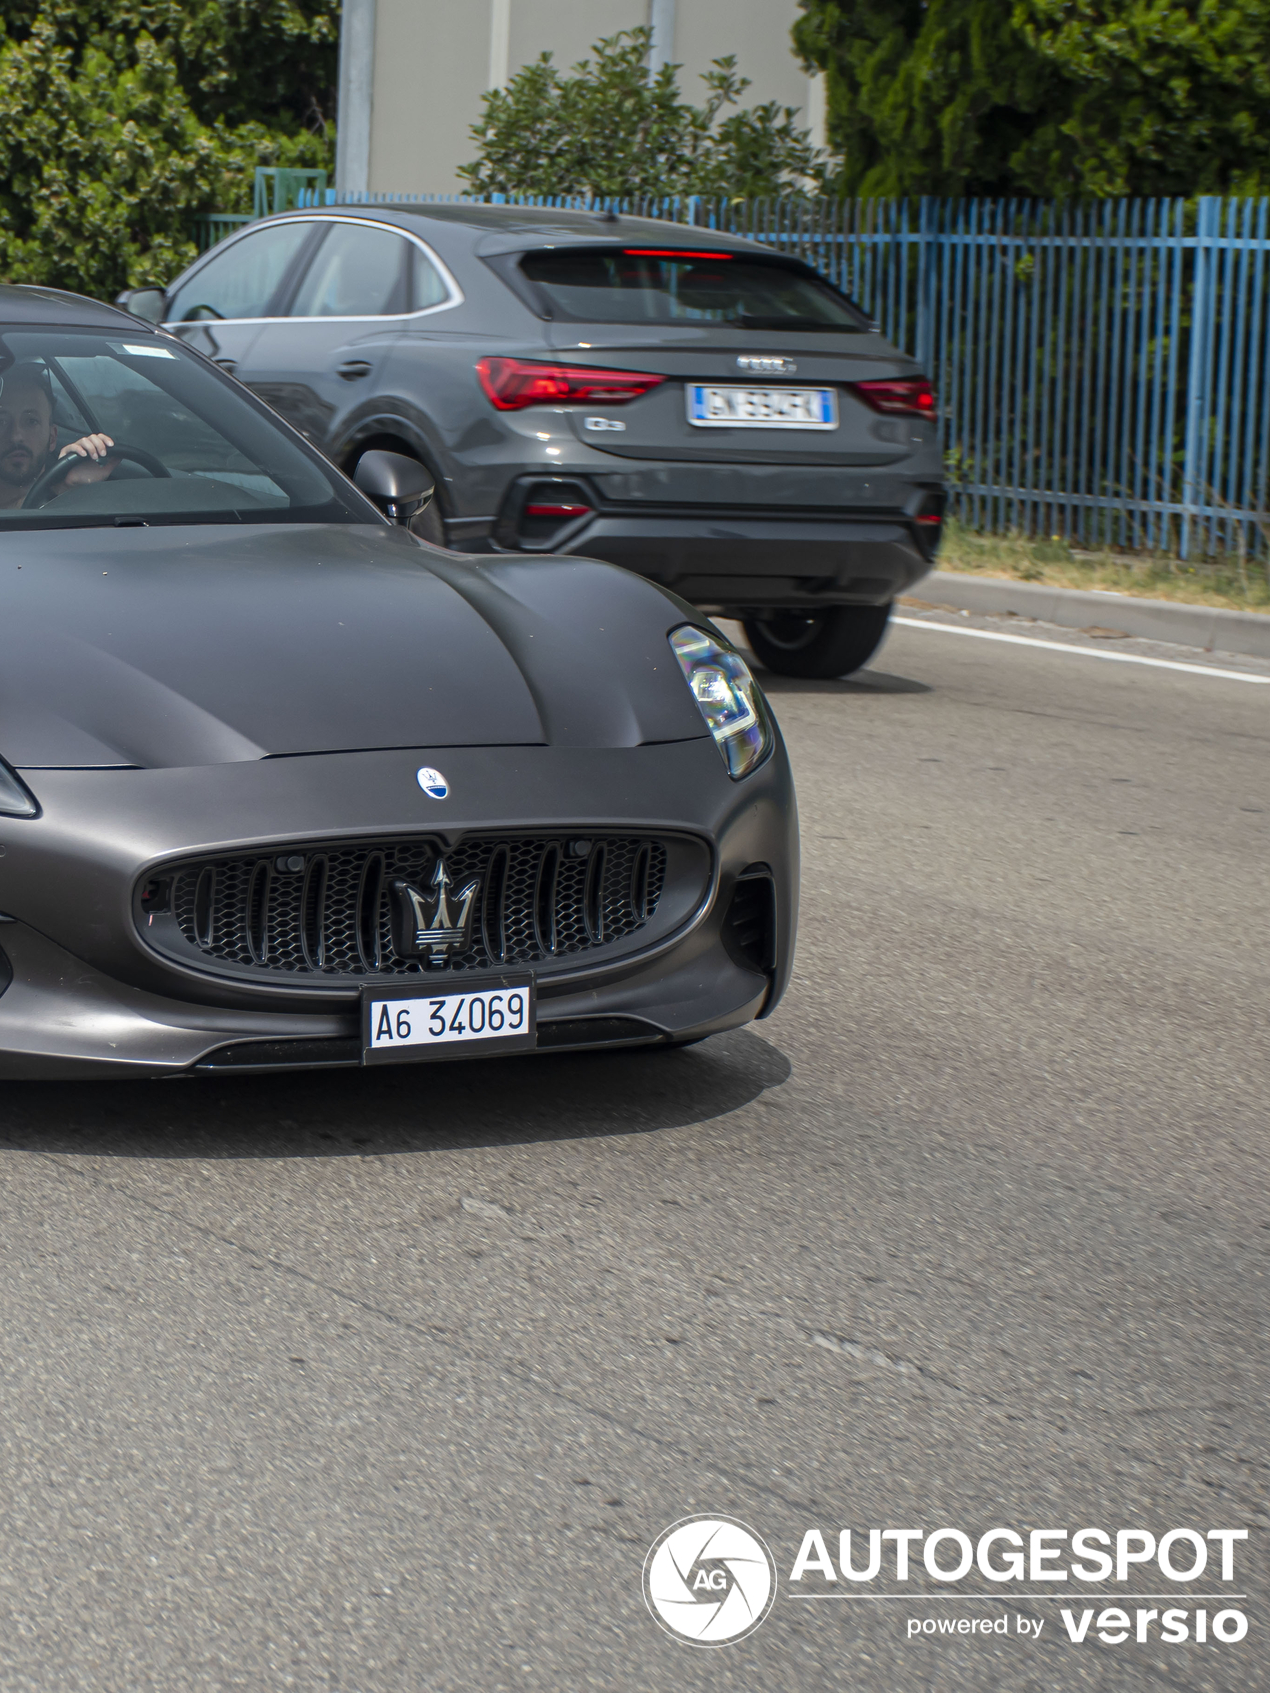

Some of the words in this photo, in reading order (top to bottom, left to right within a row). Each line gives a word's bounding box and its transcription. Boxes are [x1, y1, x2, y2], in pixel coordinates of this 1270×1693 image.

[584, 416, 626, 431] Q3
[375, 1003, 412, 1040] A6
[428, 993, 524, 1037] 34069
